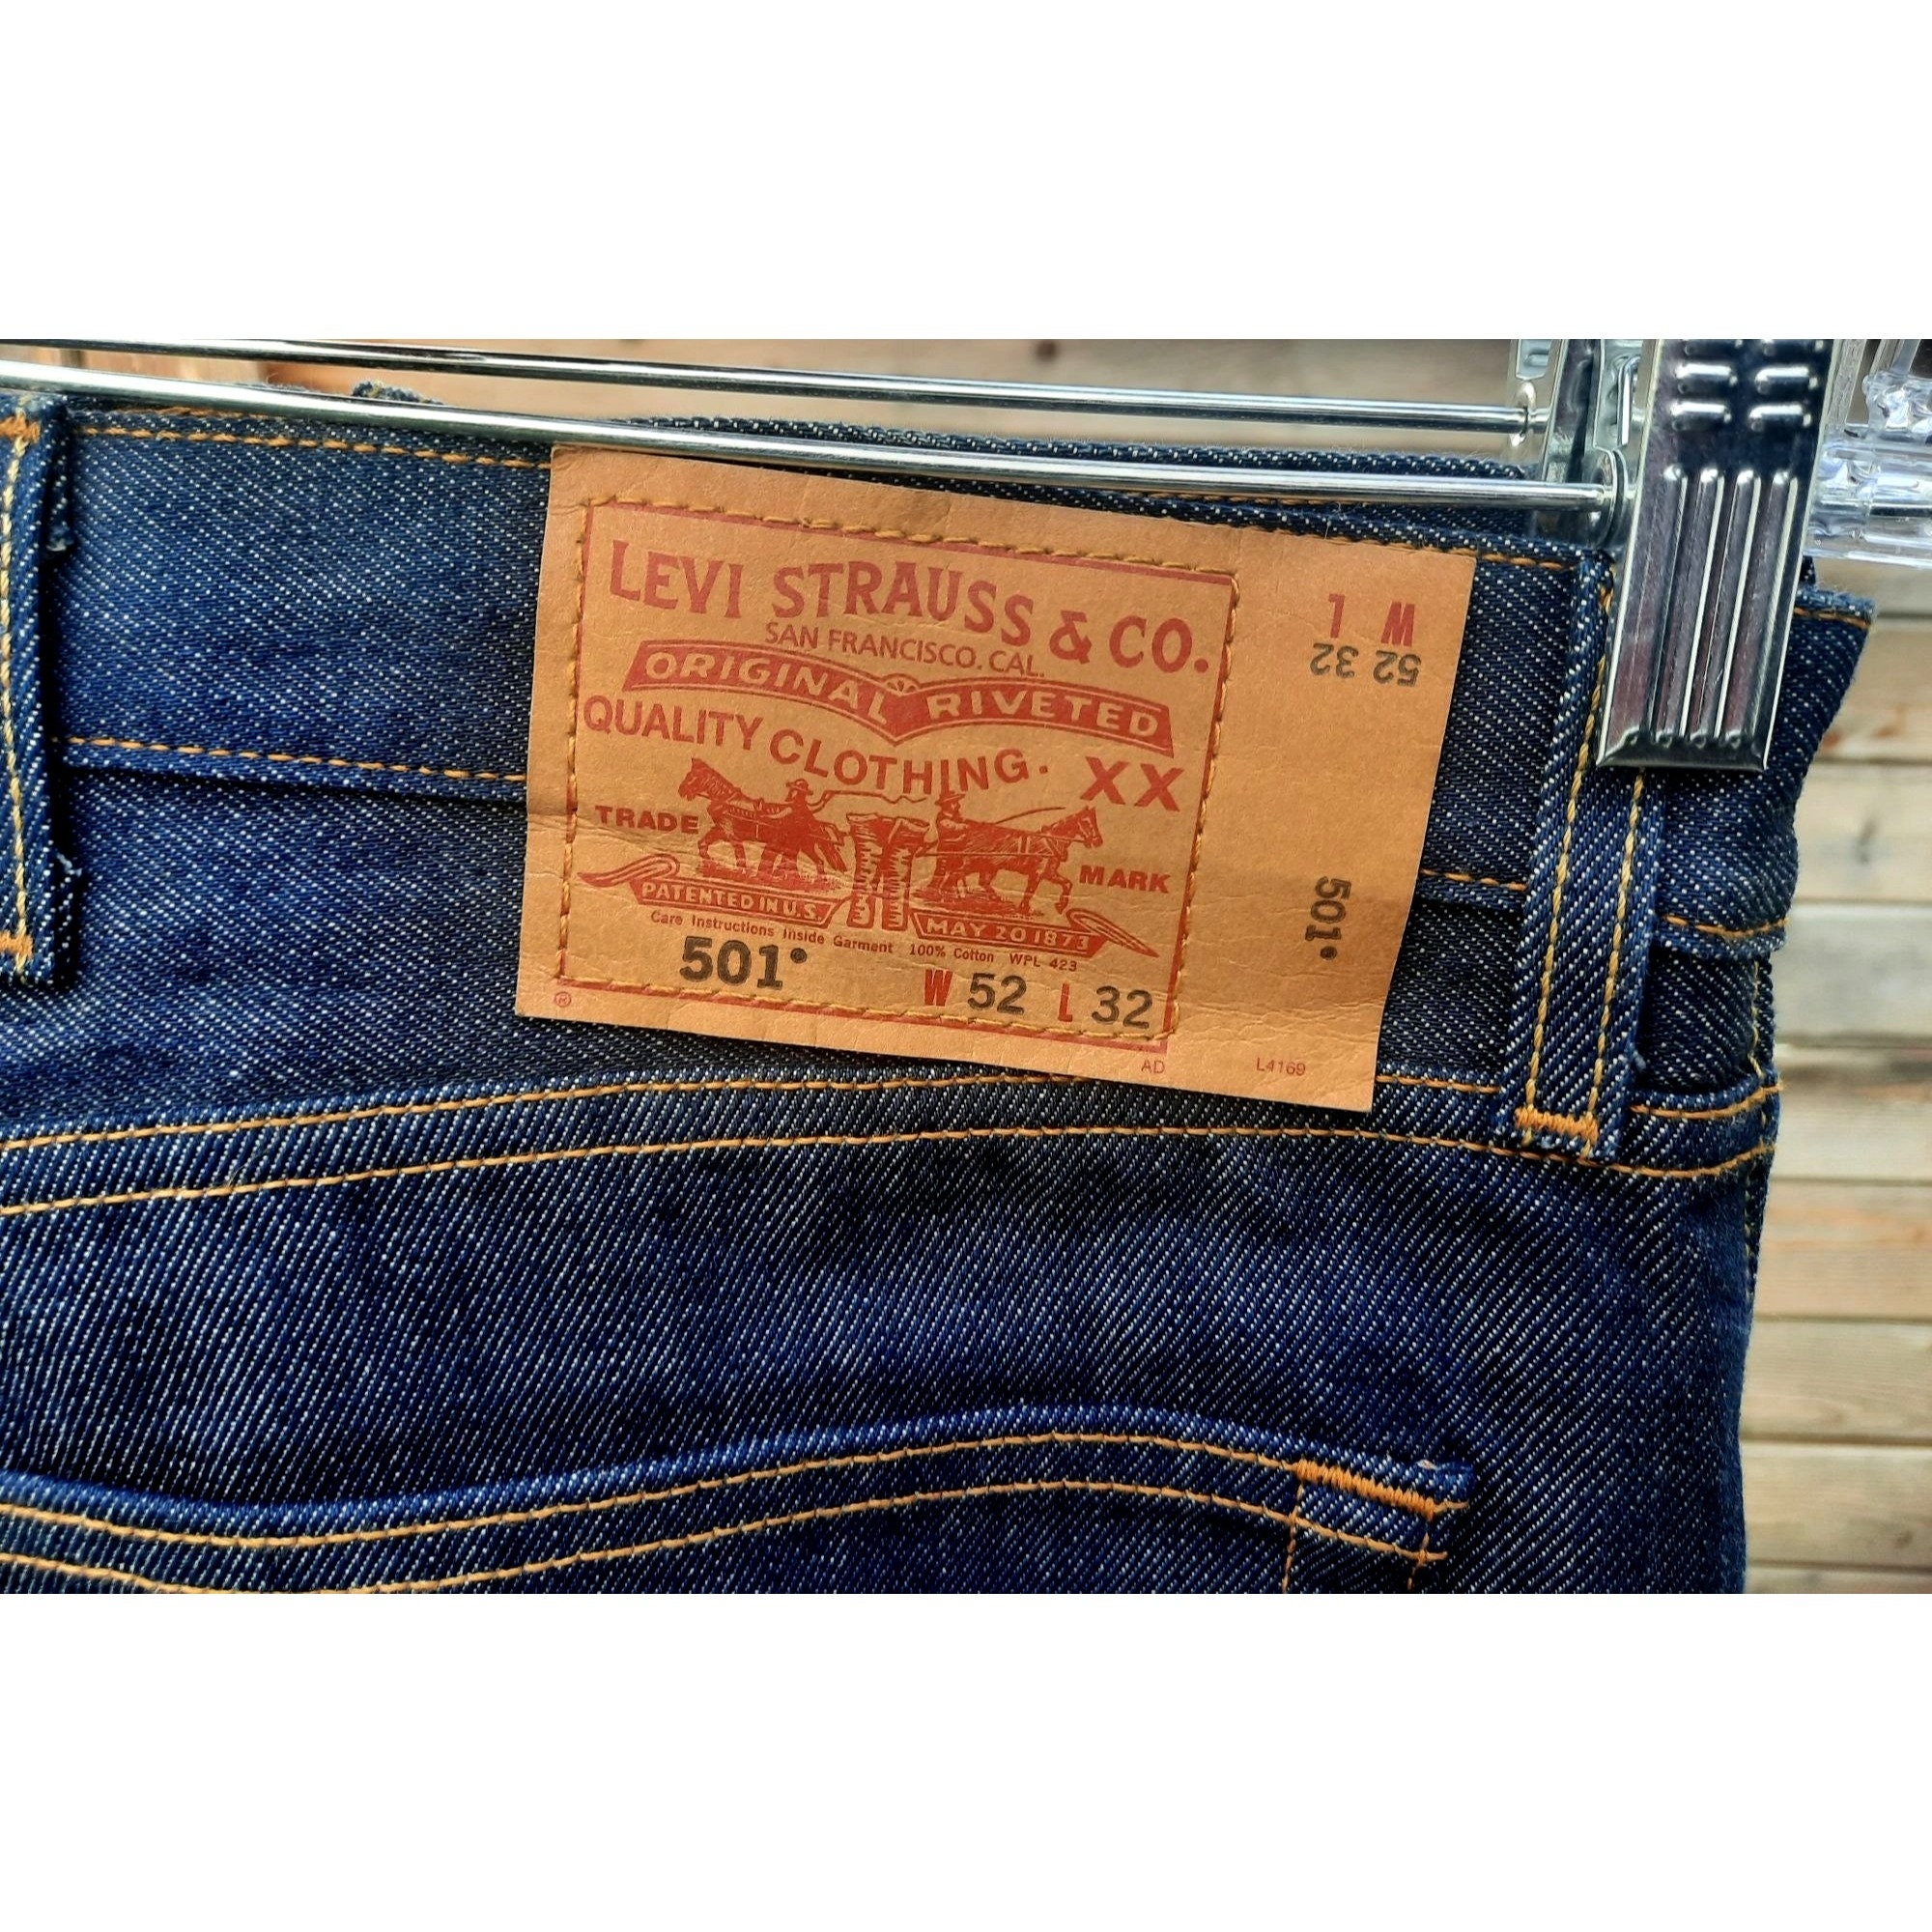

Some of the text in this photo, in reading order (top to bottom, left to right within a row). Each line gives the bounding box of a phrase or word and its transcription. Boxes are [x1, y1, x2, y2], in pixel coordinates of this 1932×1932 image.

[609, 540, 1209, 673] LEVI STRAUSS & CO.
[765, 621, 818, 648] SAN
[988, 650, 1045, 677] CAL.
[1309, 642, 1422, 687] 52 32
[645, 652, 1159, 738] ORIGINAL RIVETED
[583, 695, 1049, 795] QUALITY CLOTHING.
[1080, 756, 1185, 812] XX
[595, 806, 699, 835] TRADE
[641, 882, 754, 908] PATENTED
[1079, 866, 1171, 894] MARK
[651, 911, 1078, 973] Care Instructions Inside Garment 100% Cotton WPL 423
[925, 918, 1090, 951] MAY 20 1873
[923, 969, 1153, 1029] W 52 L 32
[1141, 1060, 1166, 1075] AD
[1256, 1057, 1306, 1076] L4169
